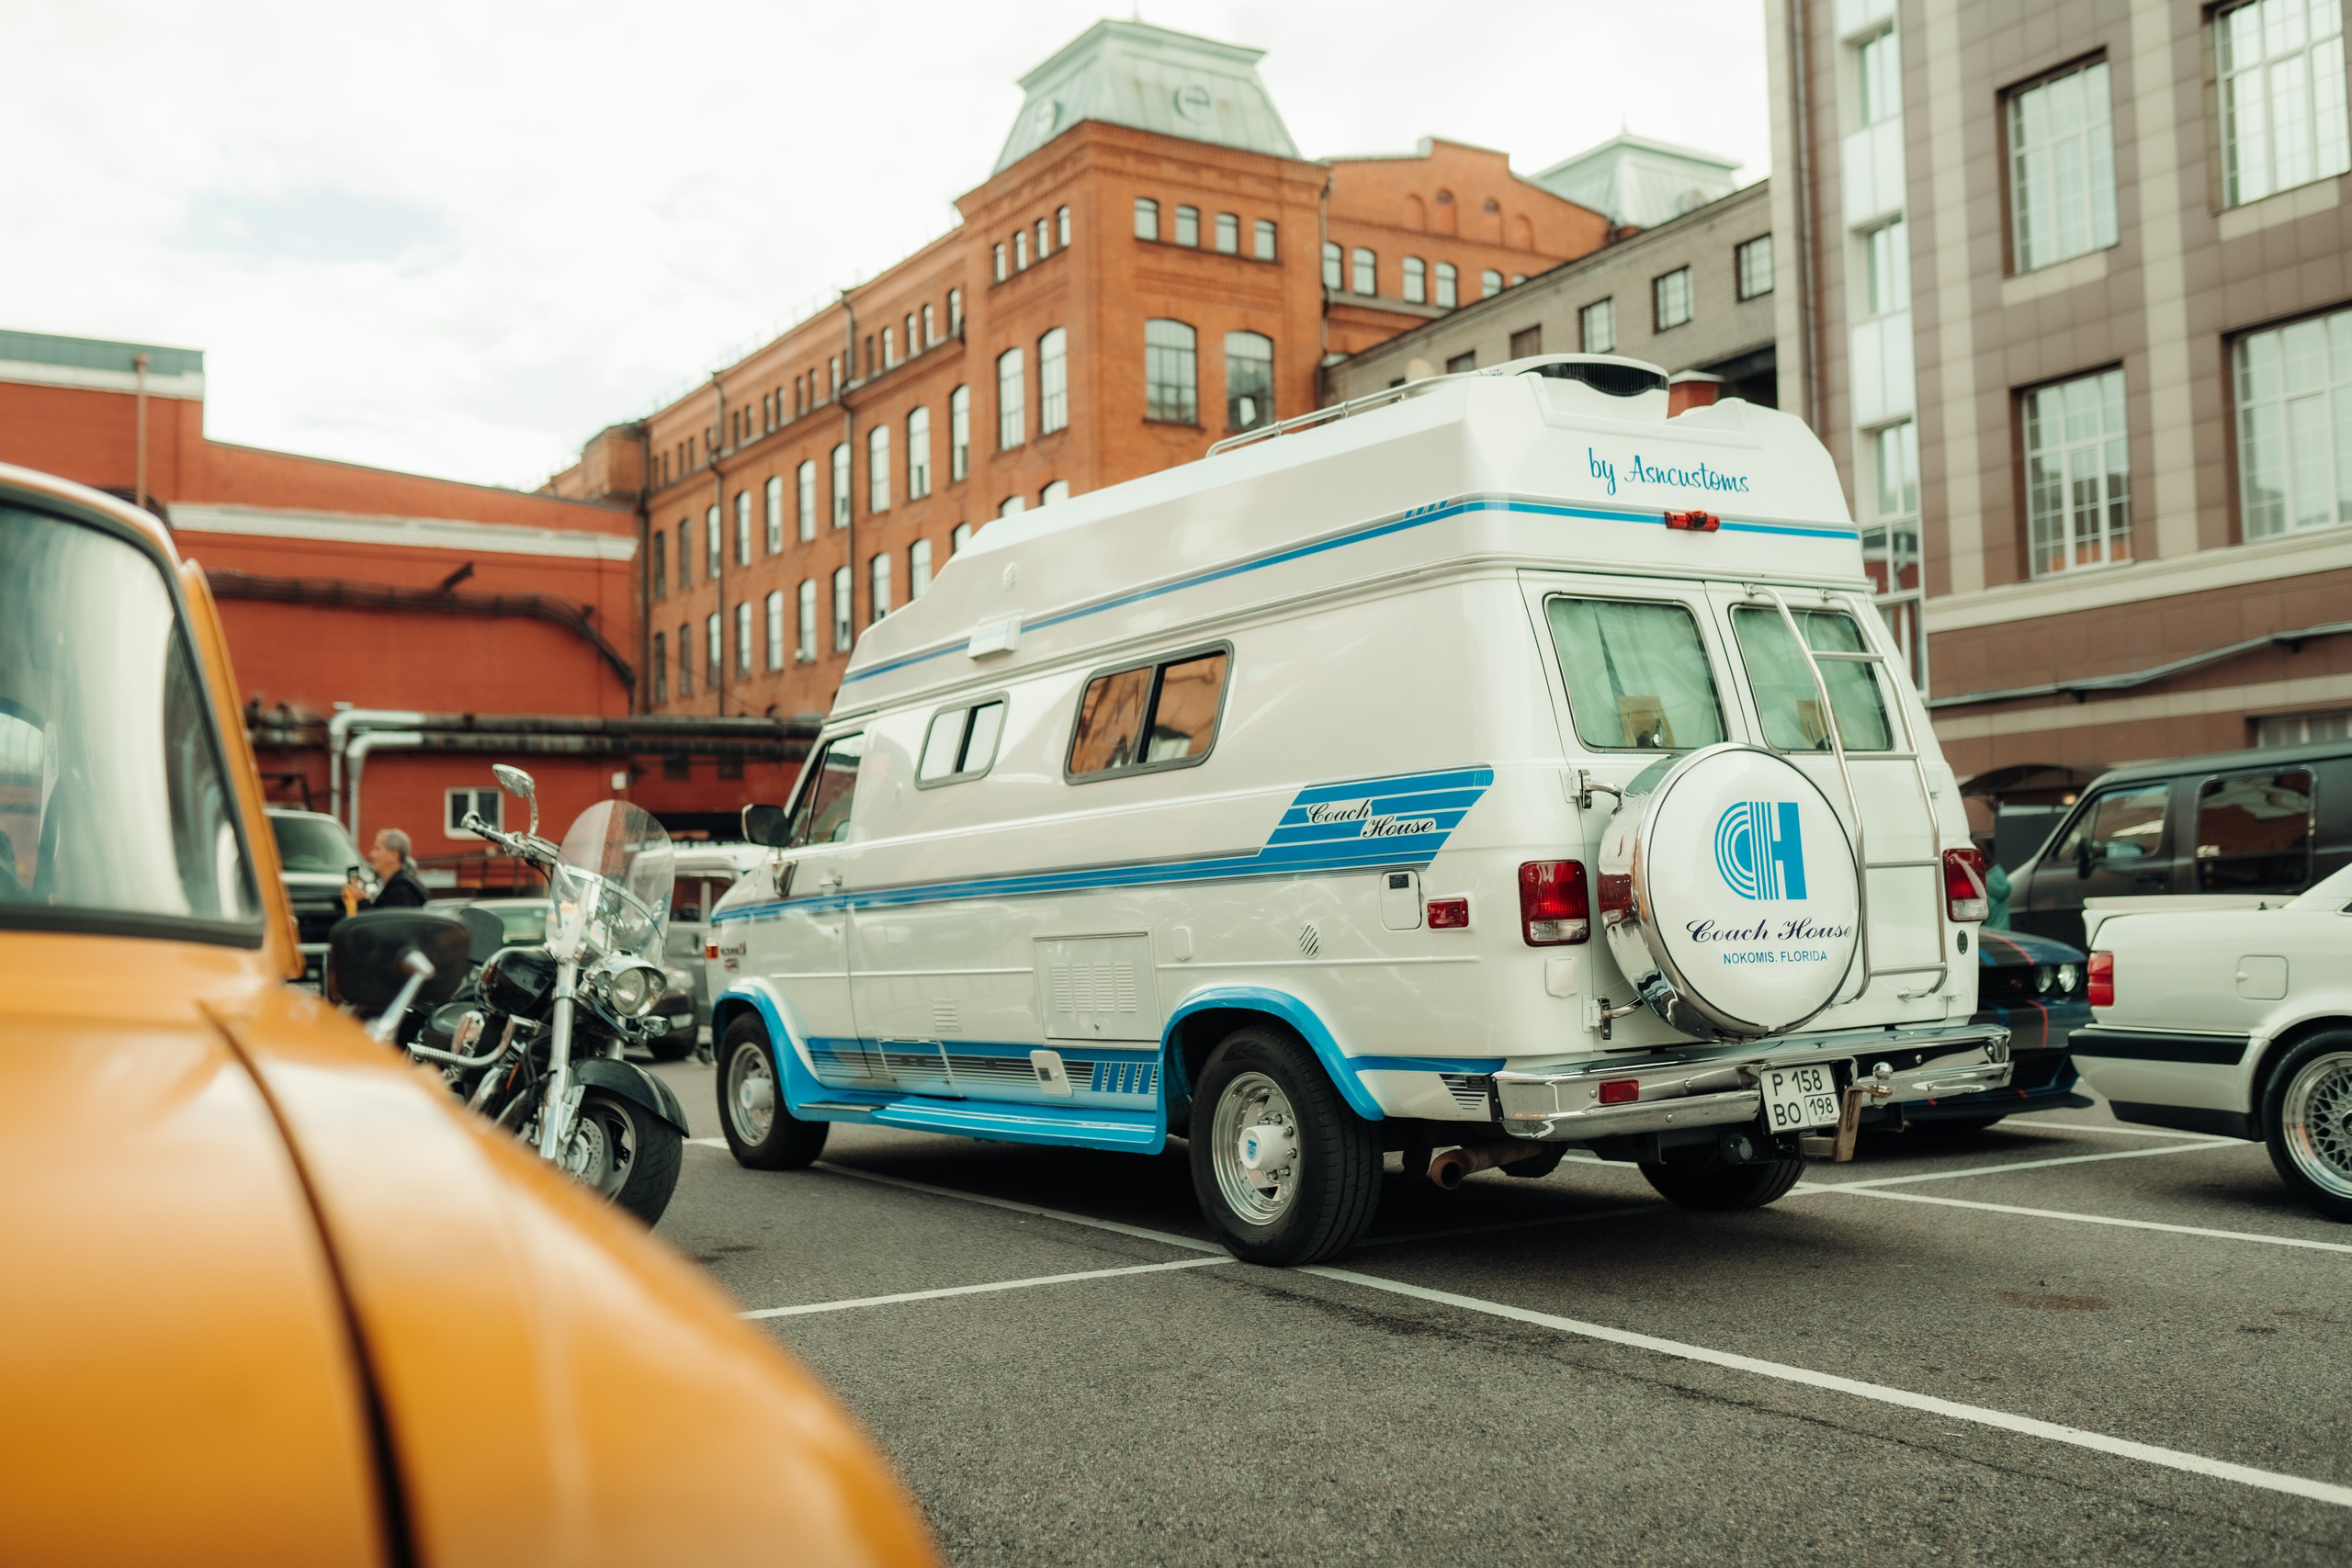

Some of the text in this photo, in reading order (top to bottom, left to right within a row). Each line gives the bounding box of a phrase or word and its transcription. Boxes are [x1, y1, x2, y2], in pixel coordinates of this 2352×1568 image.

[1588, 447, 1616, 496] by
[1308, 798, 1370, 825] Coach
[1363, 815, 1434, 839] House
[1686, 917, 1852, 943] Coach House
[1781, 950, 1828, 963] FLORIDA
[1771, 1068, 1823, 1097] P 158
[1773, 1102, 1802, 1126] BO
[1809, 1097, 1834, 1116] 198
